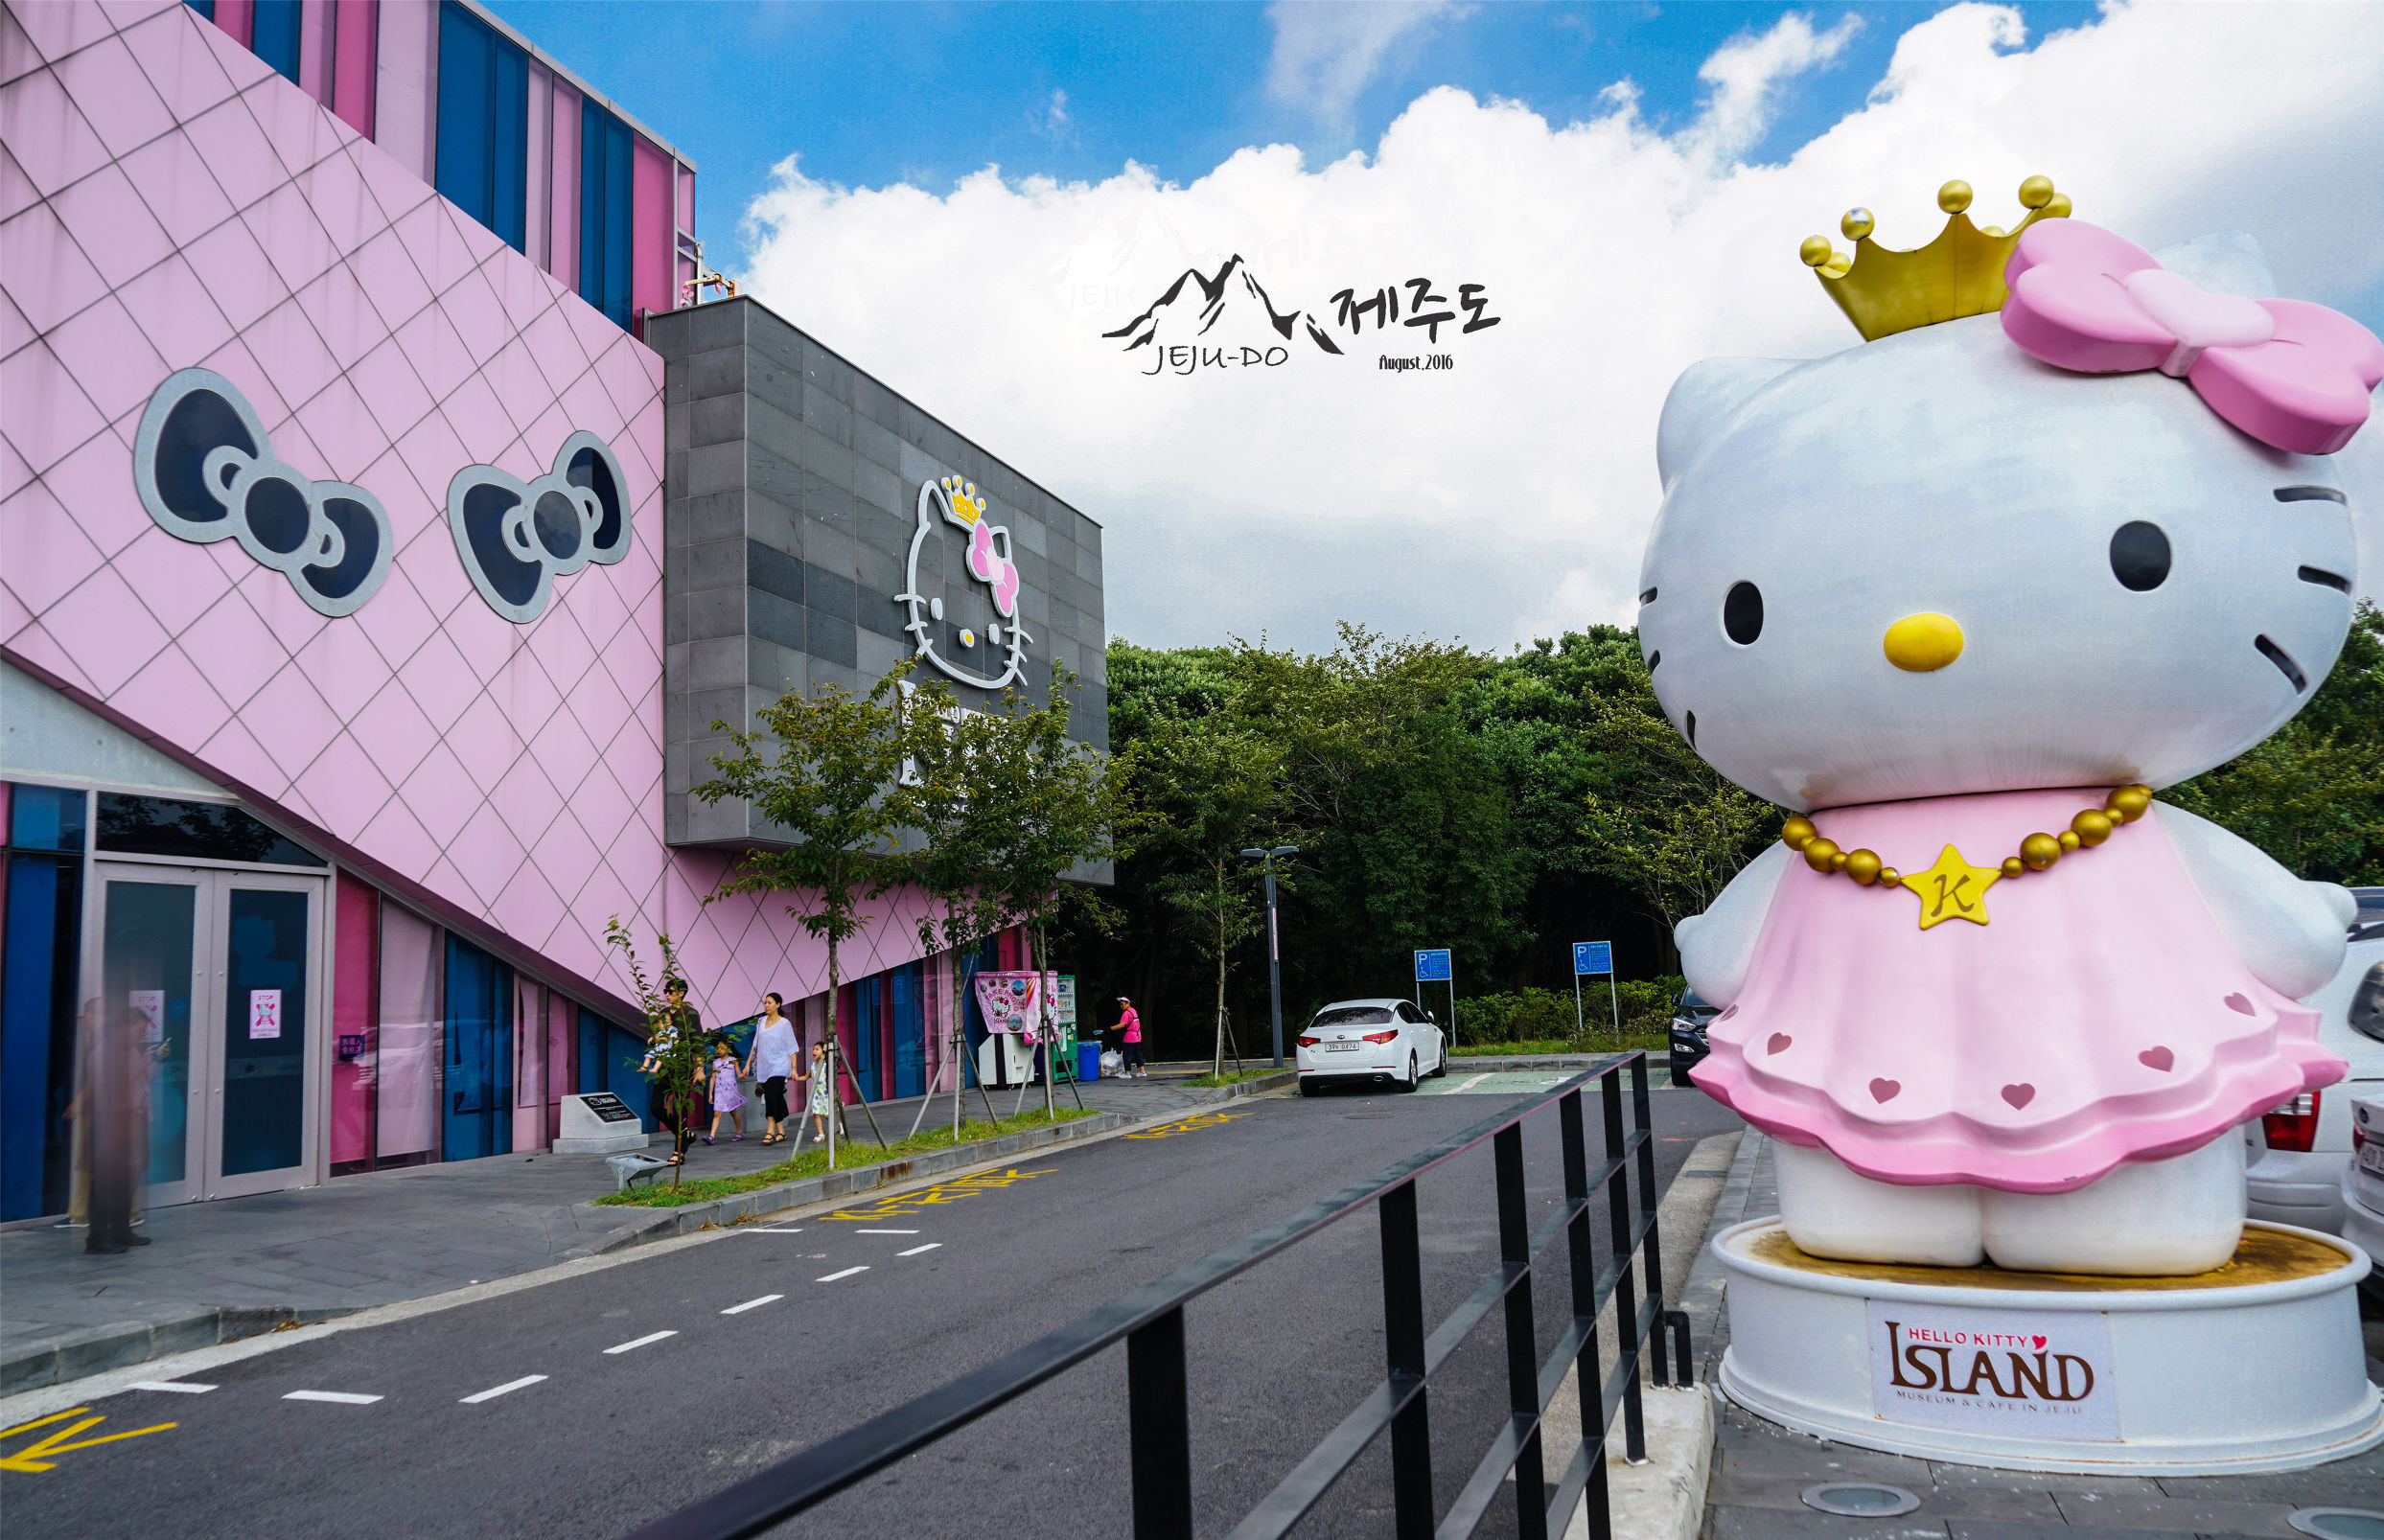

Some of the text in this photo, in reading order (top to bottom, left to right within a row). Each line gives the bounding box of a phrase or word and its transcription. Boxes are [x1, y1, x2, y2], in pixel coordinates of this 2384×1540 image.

[1930, 873, 1975, 917] K
[1419, 953, 1427, 964] P
[1577, 946, 1586, 957] P
[1909, 1328, 2027, 1347] HELLO KITTY
[1885, 1321, 2095, 1402] ISLAND
[1896, 1390, 1956, 1405] MUSEUM
[2023, 1403, 2038, 1413] IN
